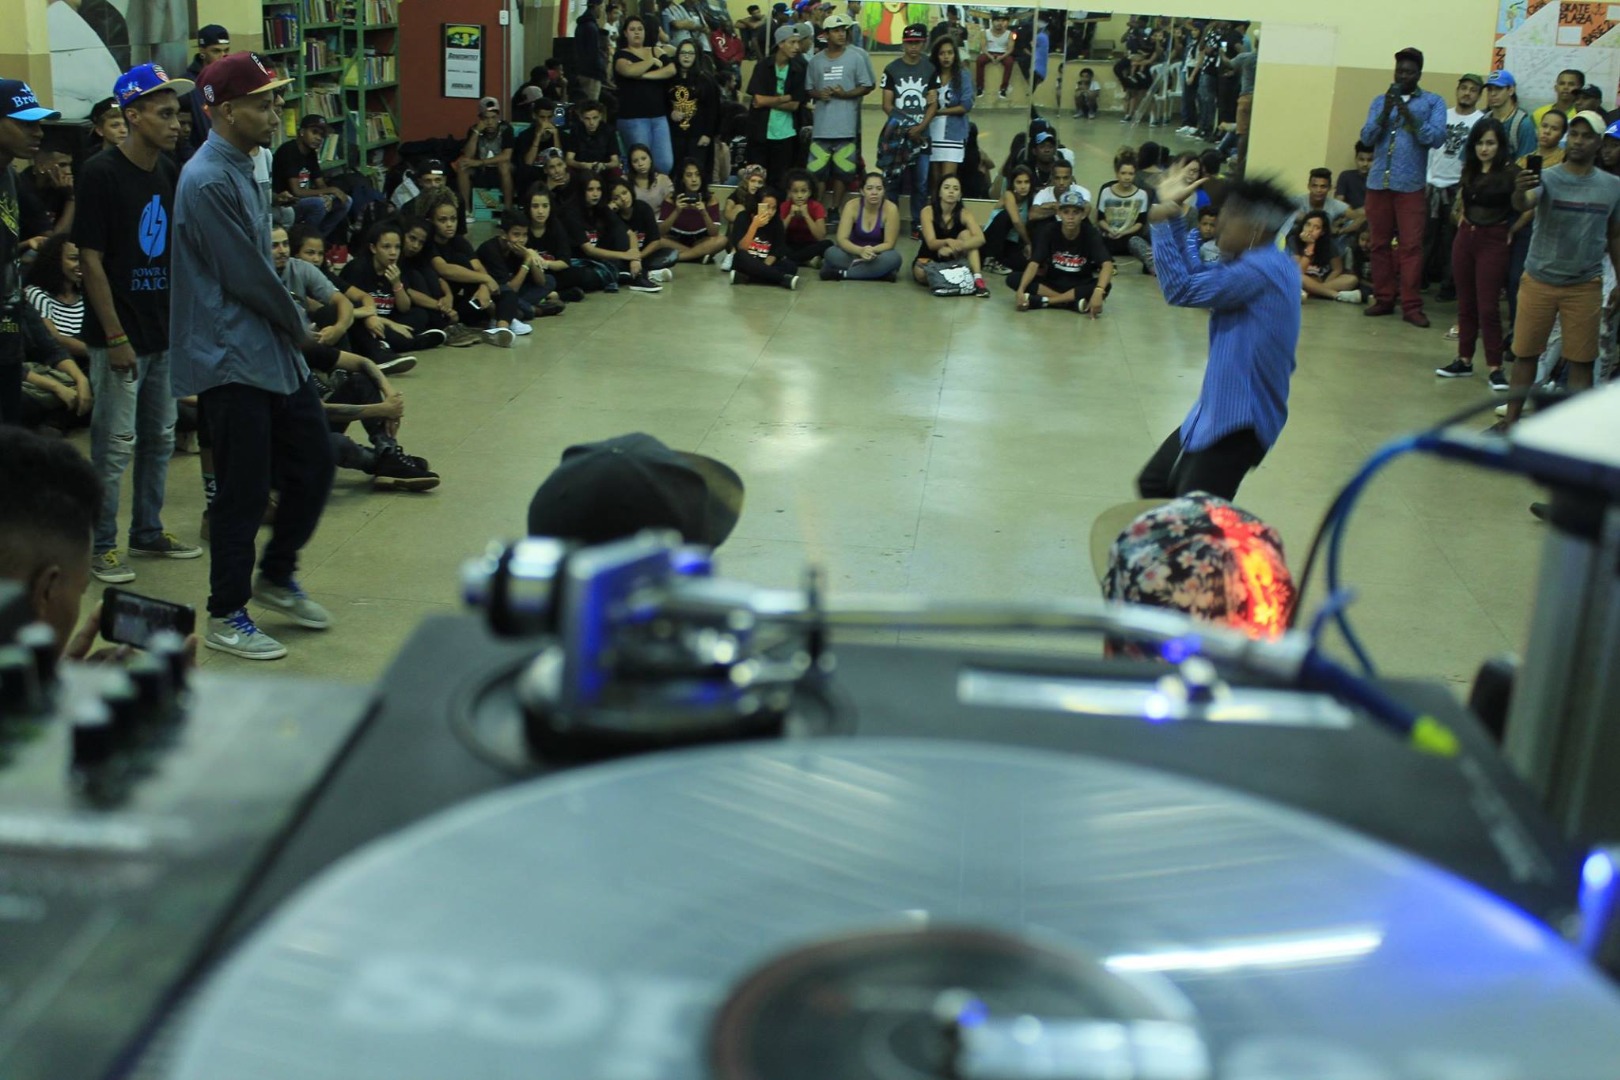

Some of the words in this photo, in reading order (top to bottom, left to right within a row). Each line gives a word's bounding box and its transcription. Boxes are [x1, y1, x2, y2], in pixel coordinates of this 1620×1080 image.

[1560, 3, 1590, 13] SKATE
[1559, 13, 1592, 24] PLAZA
[1582, 24, 1608, 46] BASE
